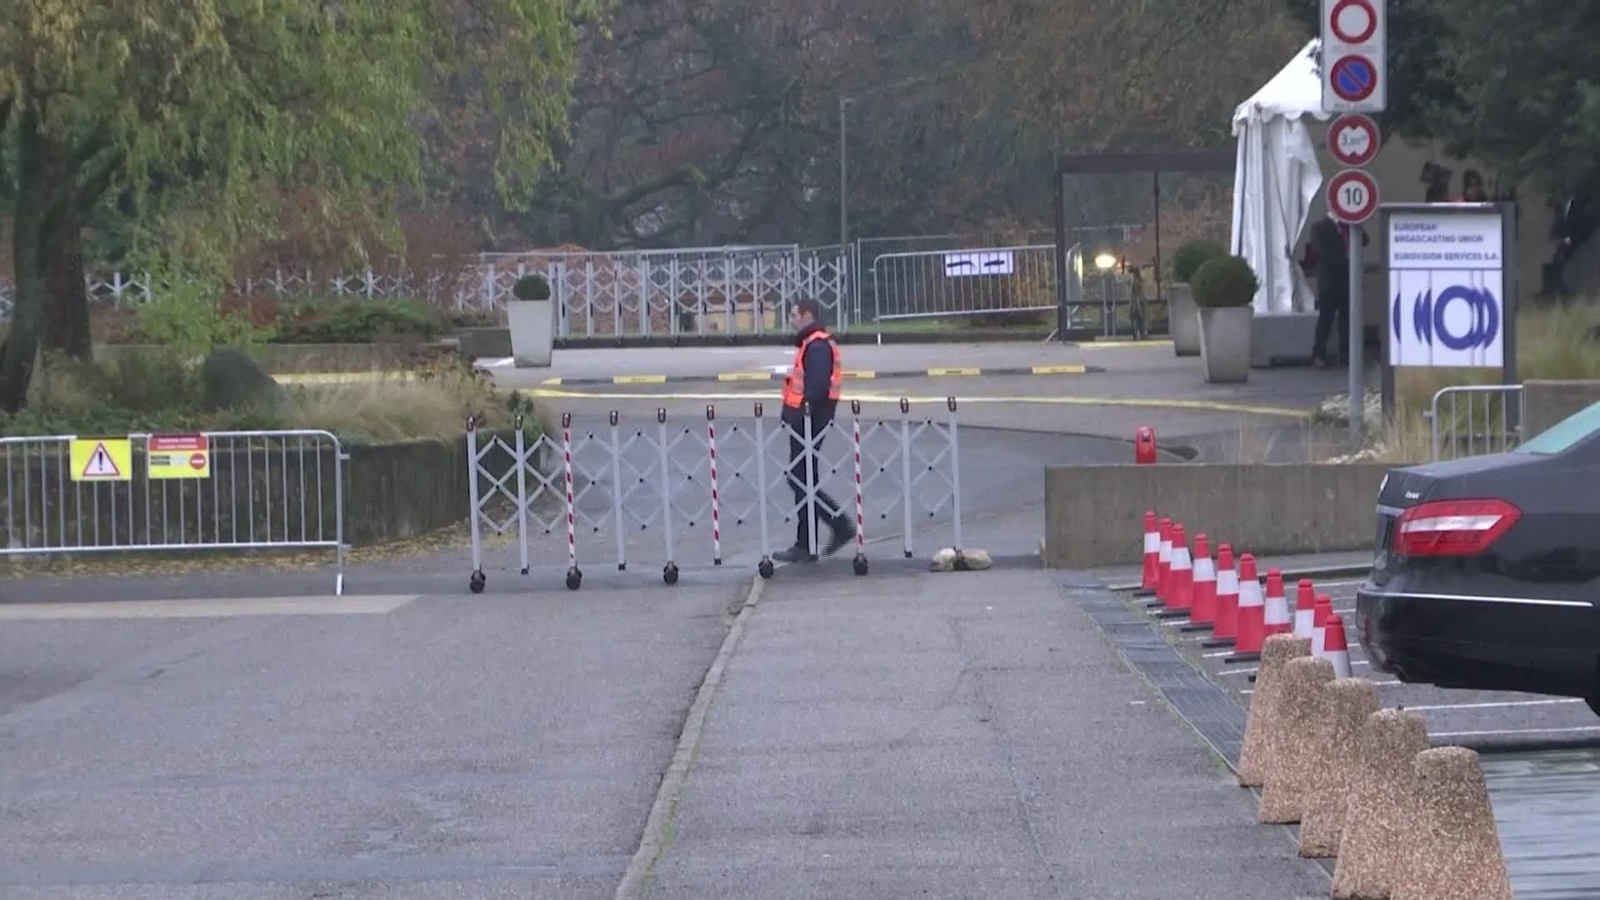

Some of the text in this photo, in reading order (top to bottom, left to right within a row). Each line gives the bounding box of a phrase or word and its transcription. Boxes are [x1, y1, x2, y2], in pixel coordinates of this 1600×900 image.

[1345, 187, 1362, 206] 10
[1394, 222, 1437, 231] EUROPEAN
[1394, 234, 1484, 243] BROADCASTING UNION
[1394, 252, 1499, 261] EUROVISION SERVICES S.A.
